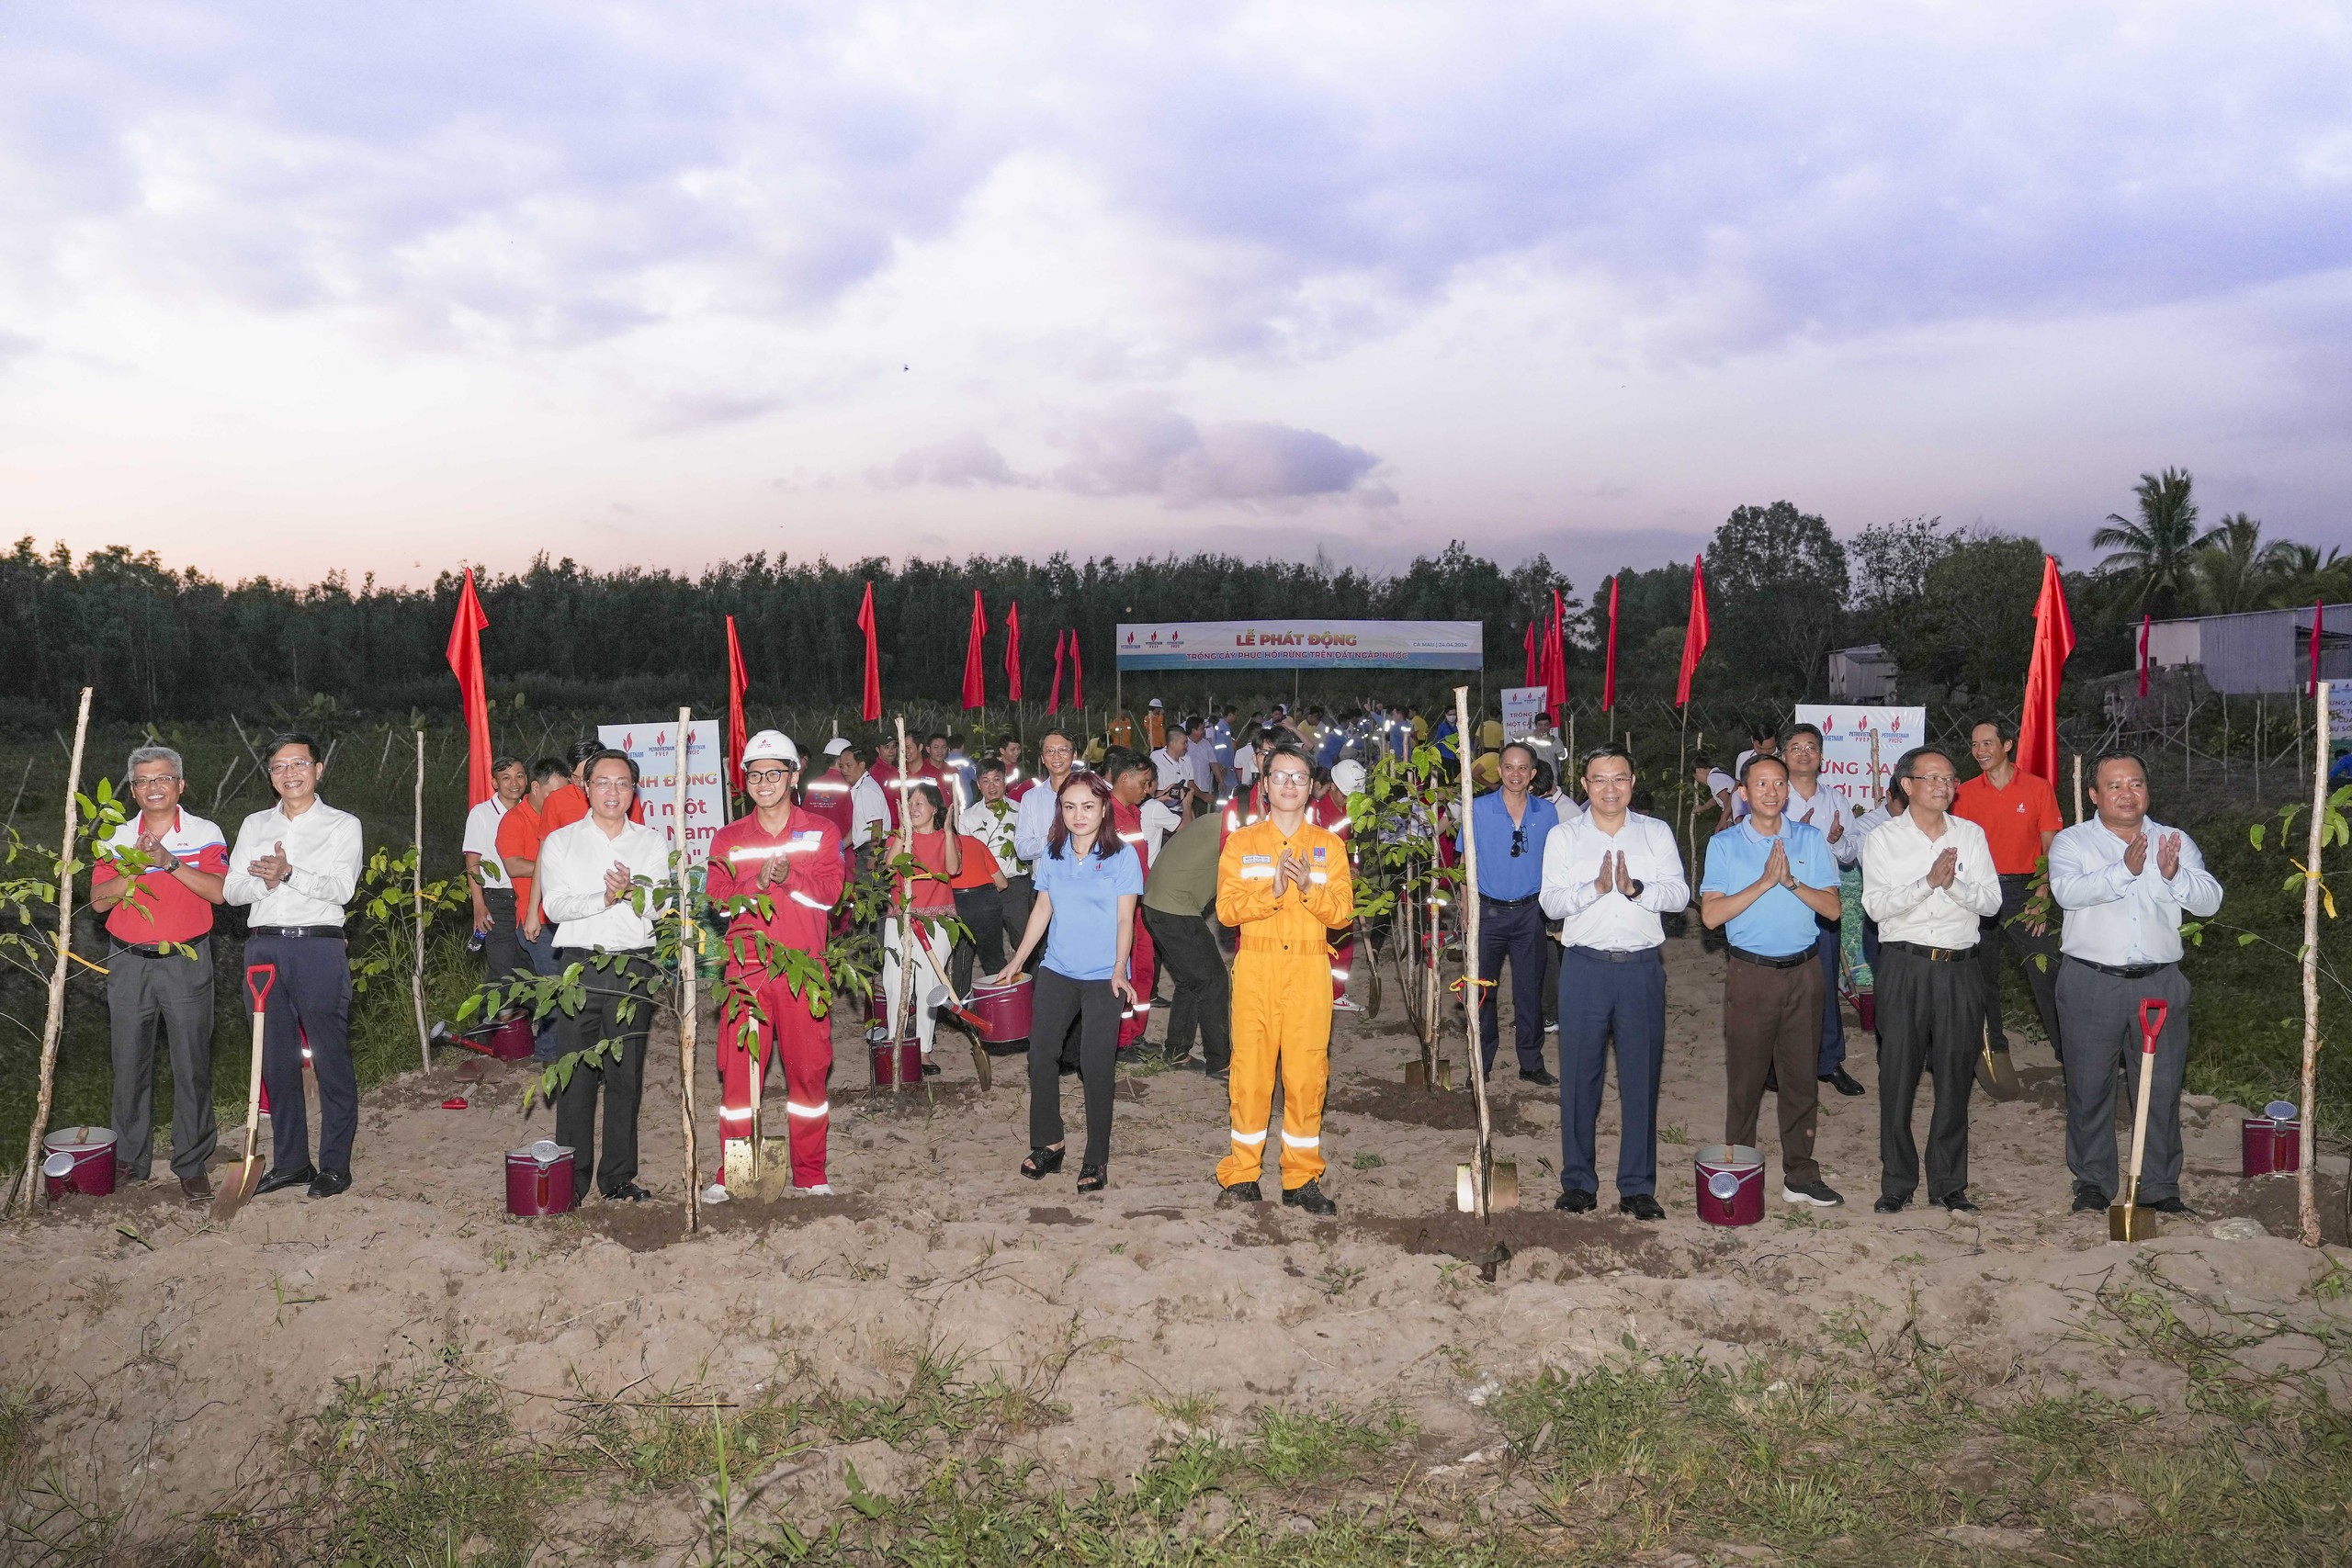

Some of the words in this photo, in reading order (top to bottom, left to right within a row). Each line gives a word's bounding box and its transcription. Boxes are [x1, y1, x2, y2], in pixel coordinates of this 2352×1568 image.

[1260, 630, 1305, 646] PHÁT
[1307, 631, 1357, 649] ĐỘNG
[1821, 757, 1859, 775] ỪNG
[662, 773, 718, 787] ĐNG
